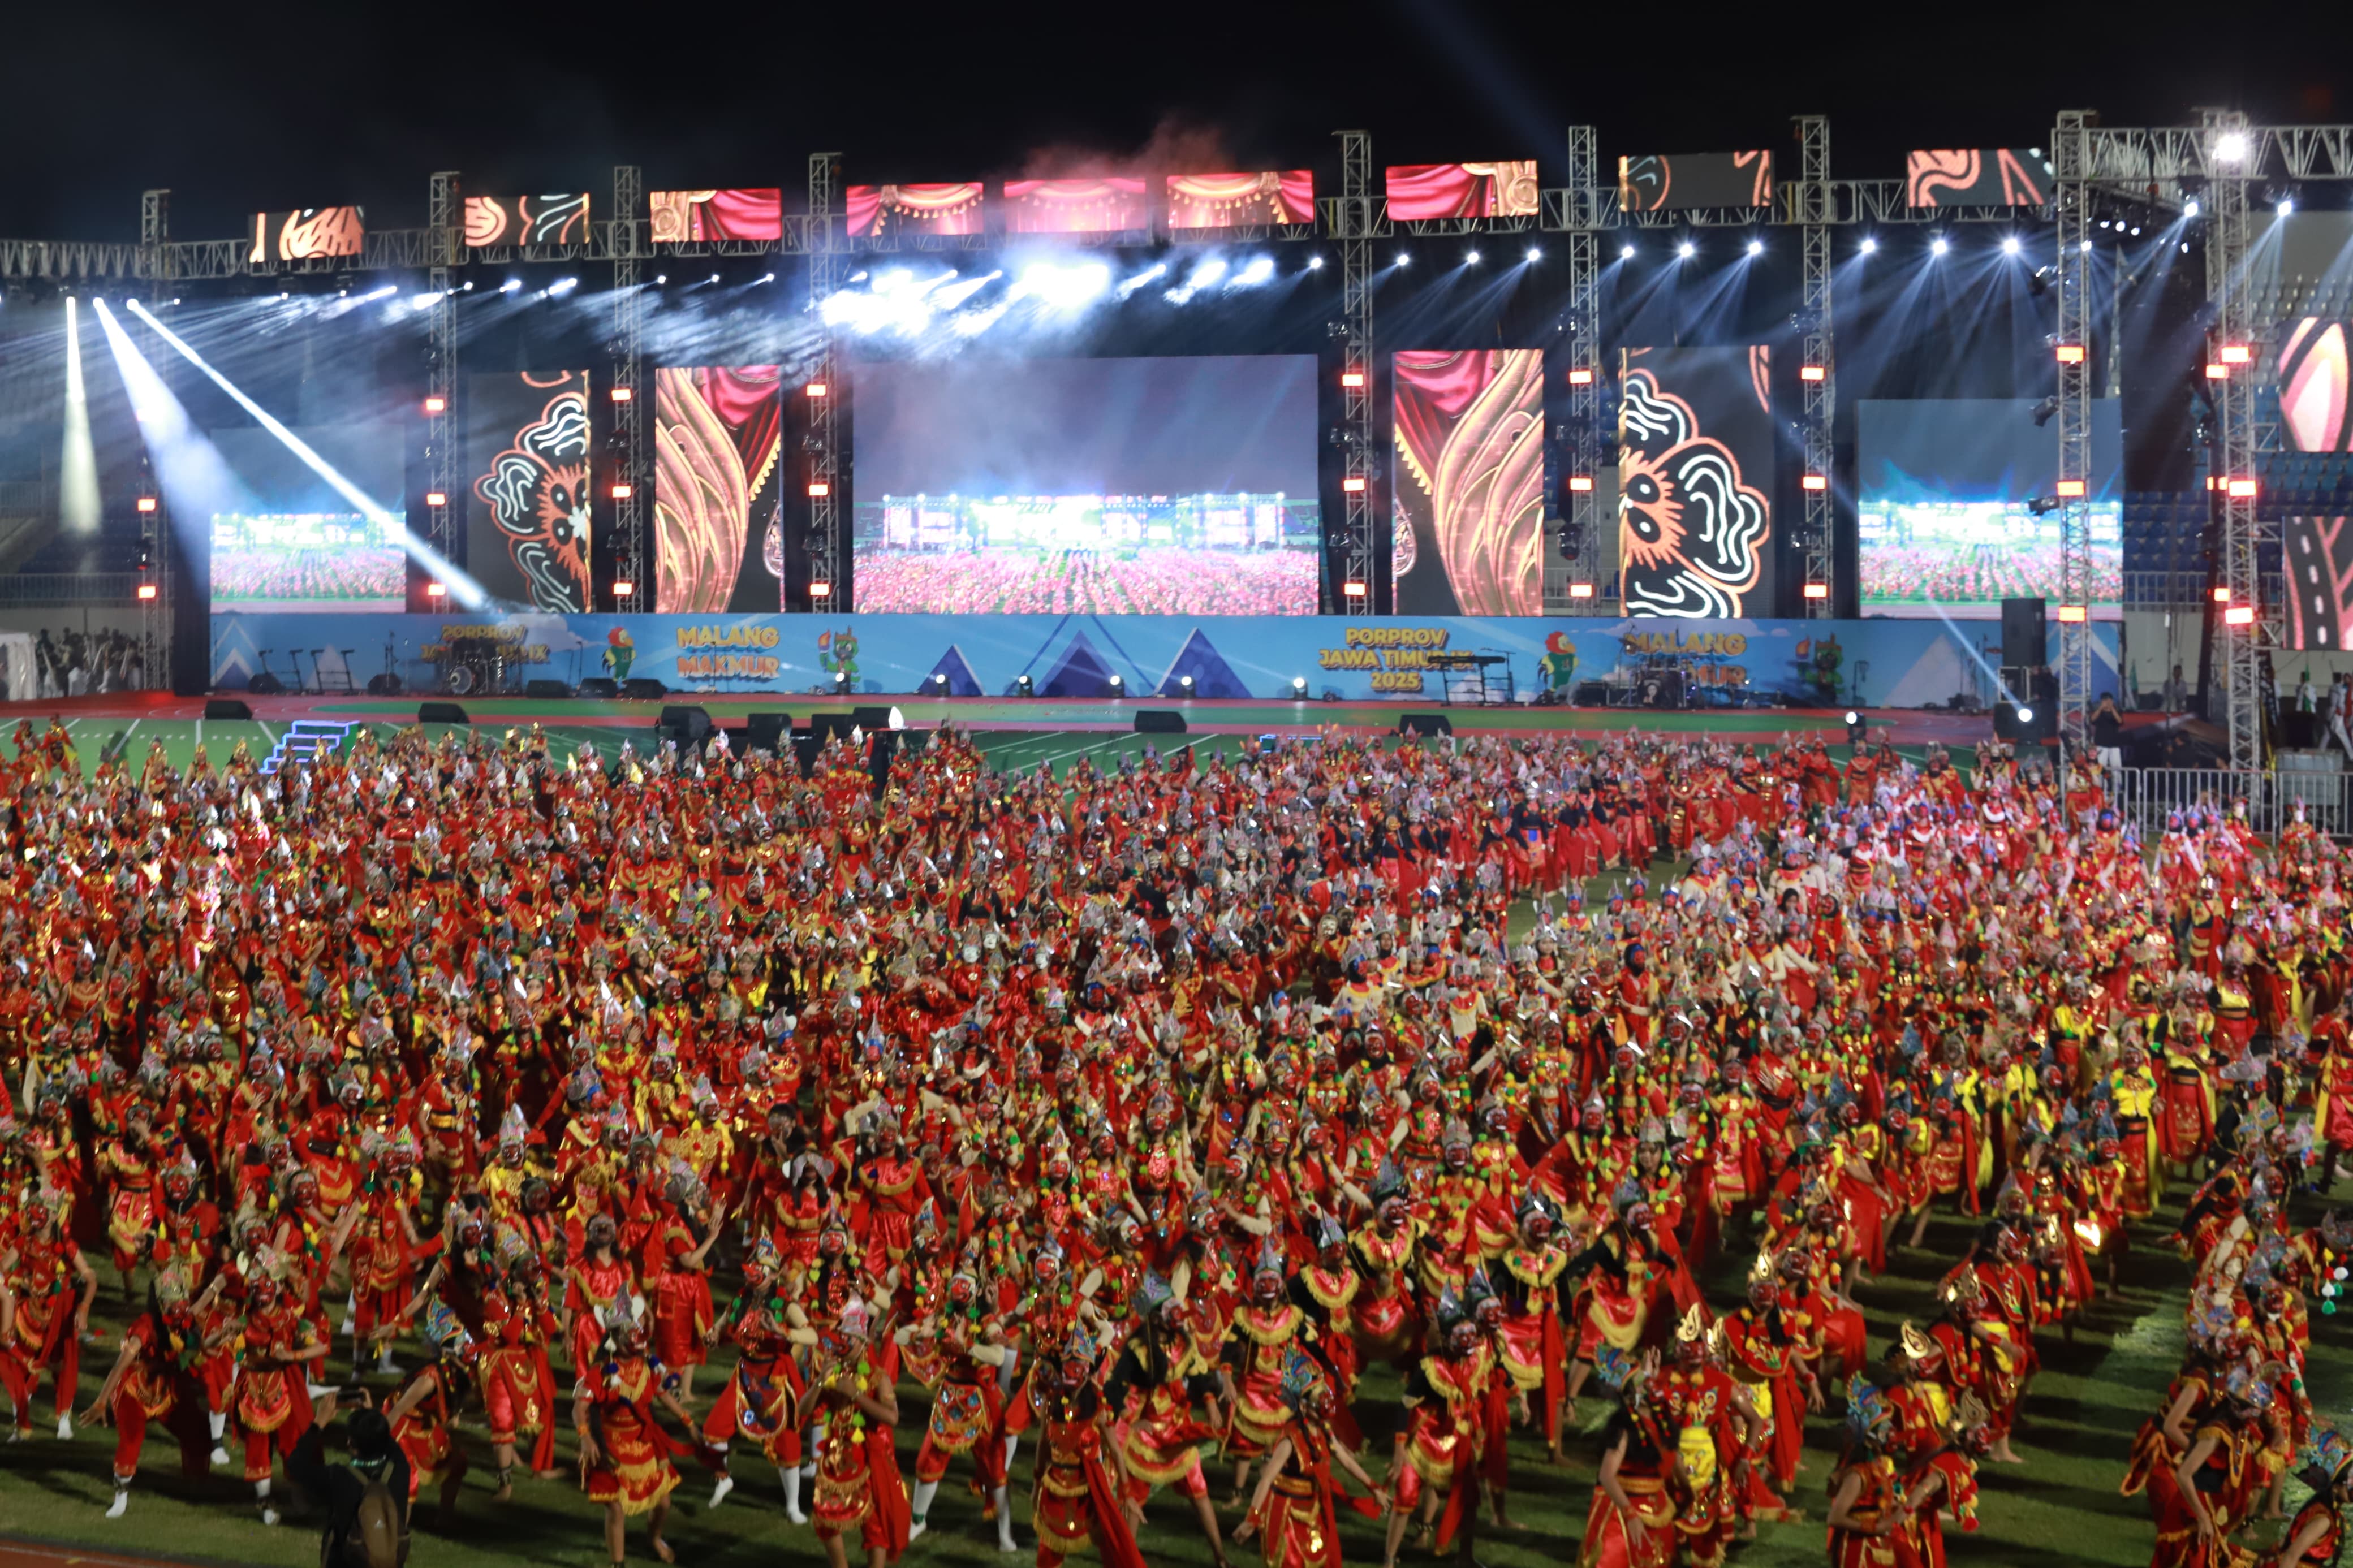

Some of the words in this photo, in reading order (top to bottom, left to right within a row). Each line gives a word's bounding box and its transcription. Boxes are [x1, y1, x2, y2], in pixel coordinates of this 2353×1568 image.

[441, 624, 527, 640] PORPROV
[676, 626, 780, 648] MALANG
[1346, 628, 1447, 646] PORPROV
[1622, 632, 1747, 655] MALANG
[676, 655, 780, 677] MAKMUR
[1318, 650, 1380, 668] JAWA
[1371, 671, 1421, 691] 2025
